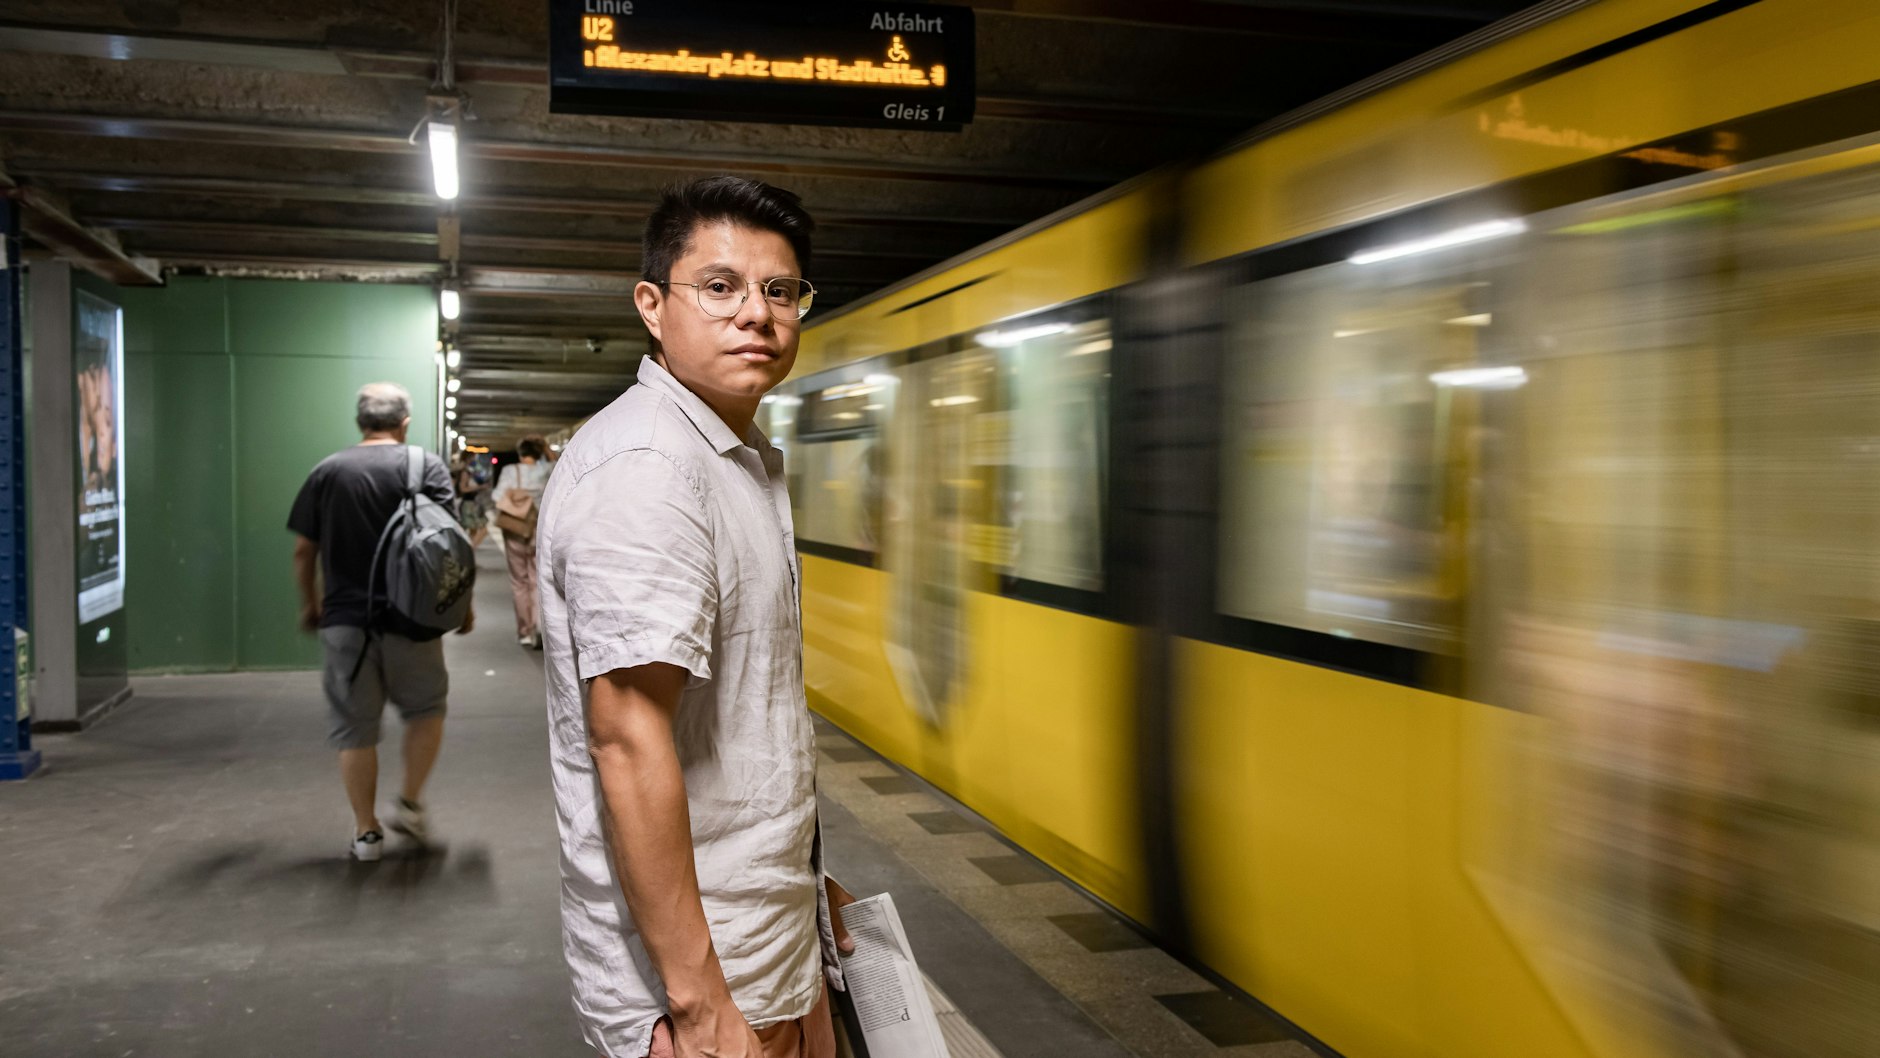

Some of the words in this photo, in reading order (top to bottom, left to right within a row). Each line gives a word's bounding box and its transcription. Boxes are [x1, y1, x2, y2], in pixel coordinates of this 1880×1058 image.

[585, 0, 633, 14] Linie
[583, 16, 614, 41] U2
[870, 12, 943, 33] Abfahrt
[595, 45, 770, 78] Alexanderplatz
[771, 57, 814, 79] und
[883, 103, 929, 121] Gleis
[937, 106, 945, 121] 1
